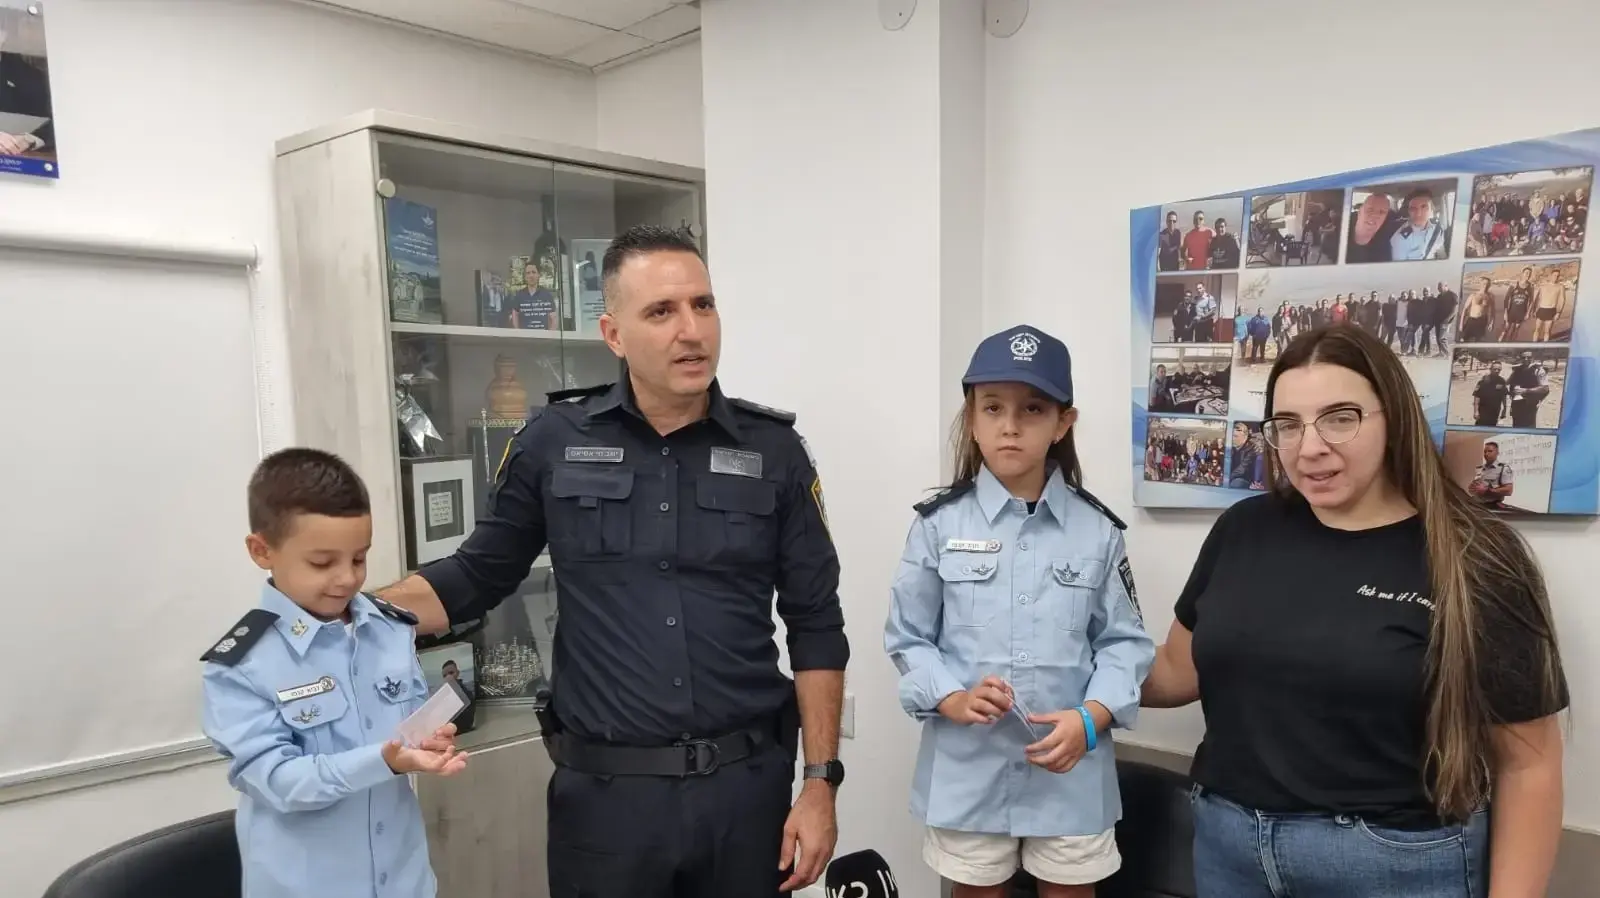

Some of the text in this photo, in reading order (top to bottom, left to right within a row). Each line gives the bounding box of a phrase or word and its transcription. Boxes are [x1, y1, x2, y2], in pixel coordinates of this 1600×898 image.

[1356, 584, 1376, 597] Ask
[1377, 591, 1394, 600] me
[1396, 592, 1409, 602] if
